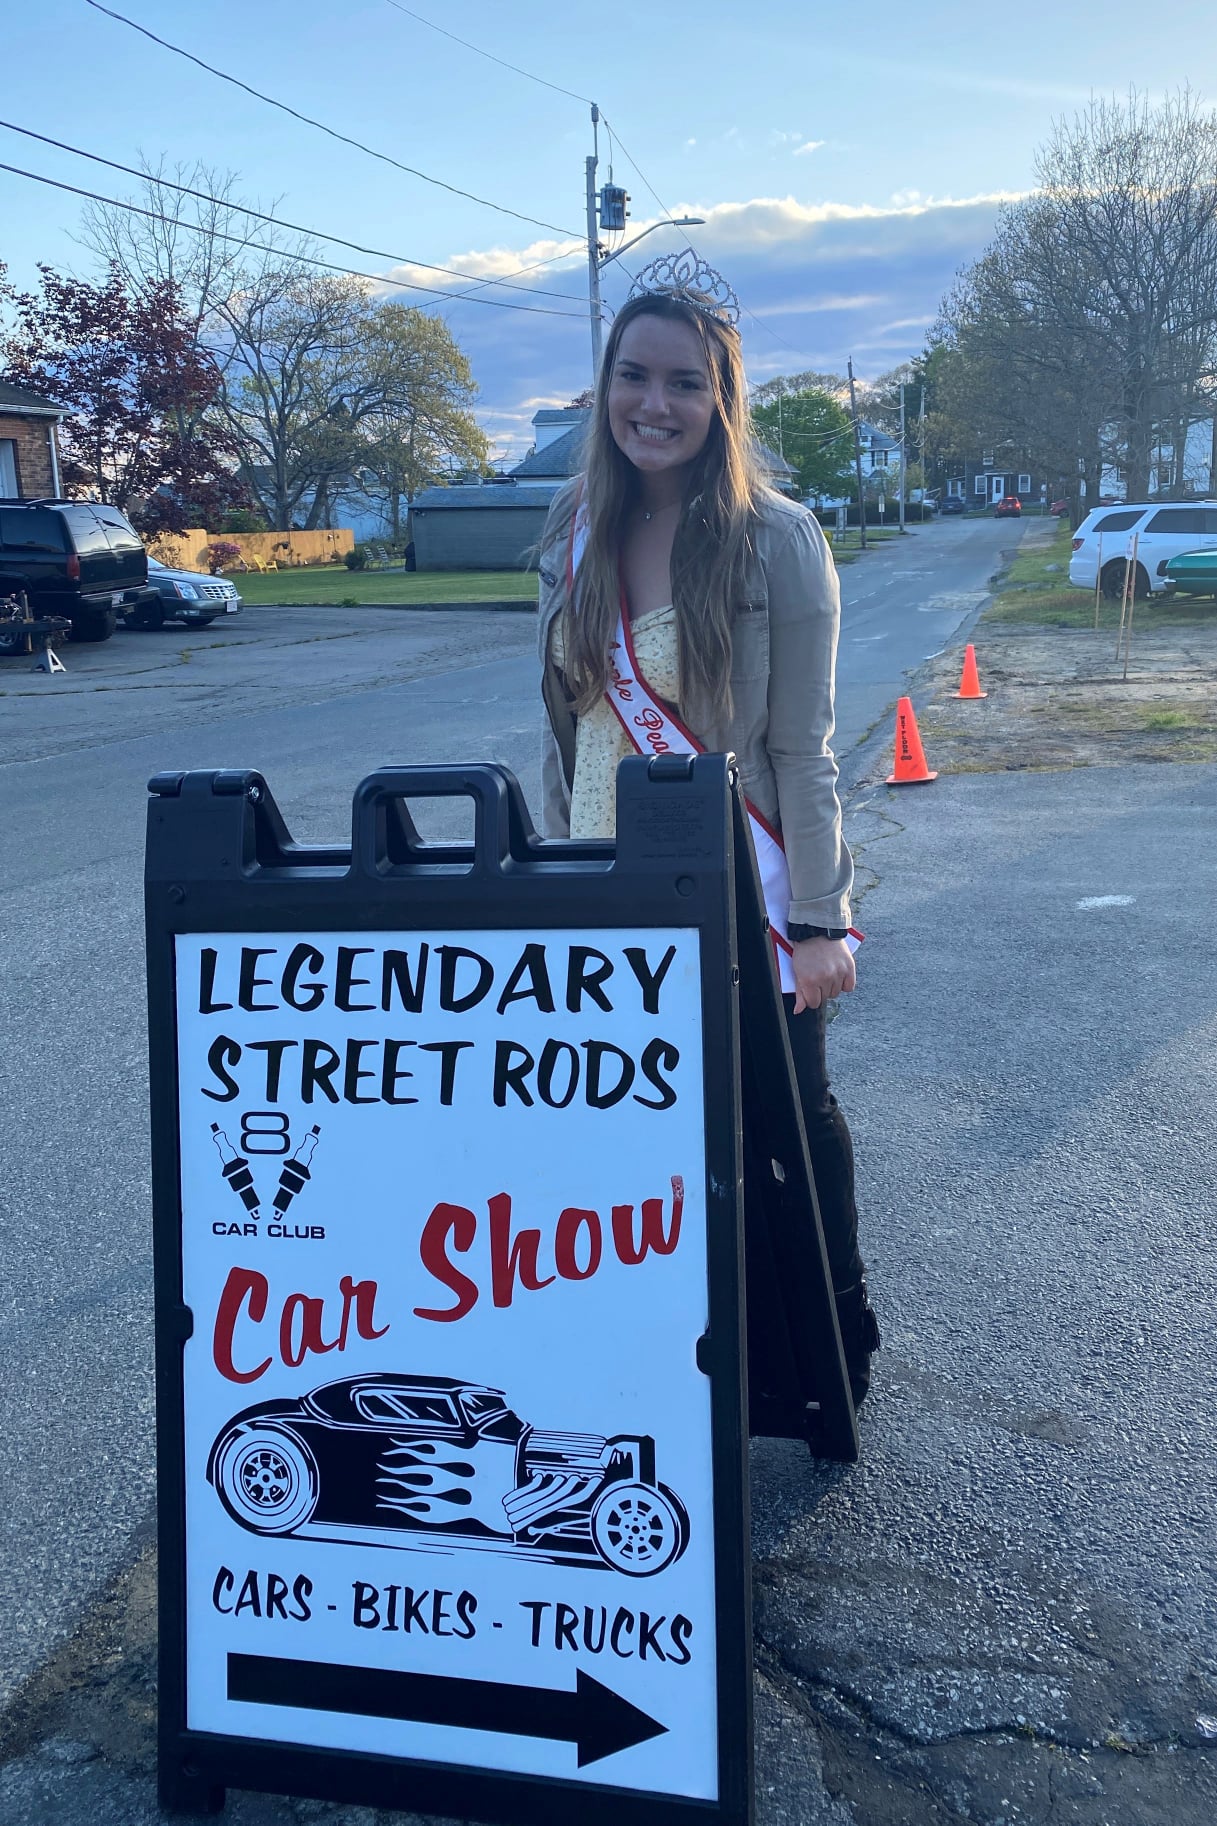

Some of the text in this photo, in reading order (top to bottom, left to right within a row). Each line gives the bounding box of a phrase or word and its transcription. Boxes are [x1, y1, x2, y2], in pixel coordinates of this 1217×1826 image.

[198, 942, 677, 1016] LEGENDARY
[200, 1034, 681, 1111] STREET RODS
[212, 1222, 326, 1240] CAR CLUB
[213, 1175, 684, 1382] Car Show
[212, 1565, 313, 1622] CARS
[351, 1580, 478, 1640] BIKES
[518, 1601, 693, 1665] TRUCKS
